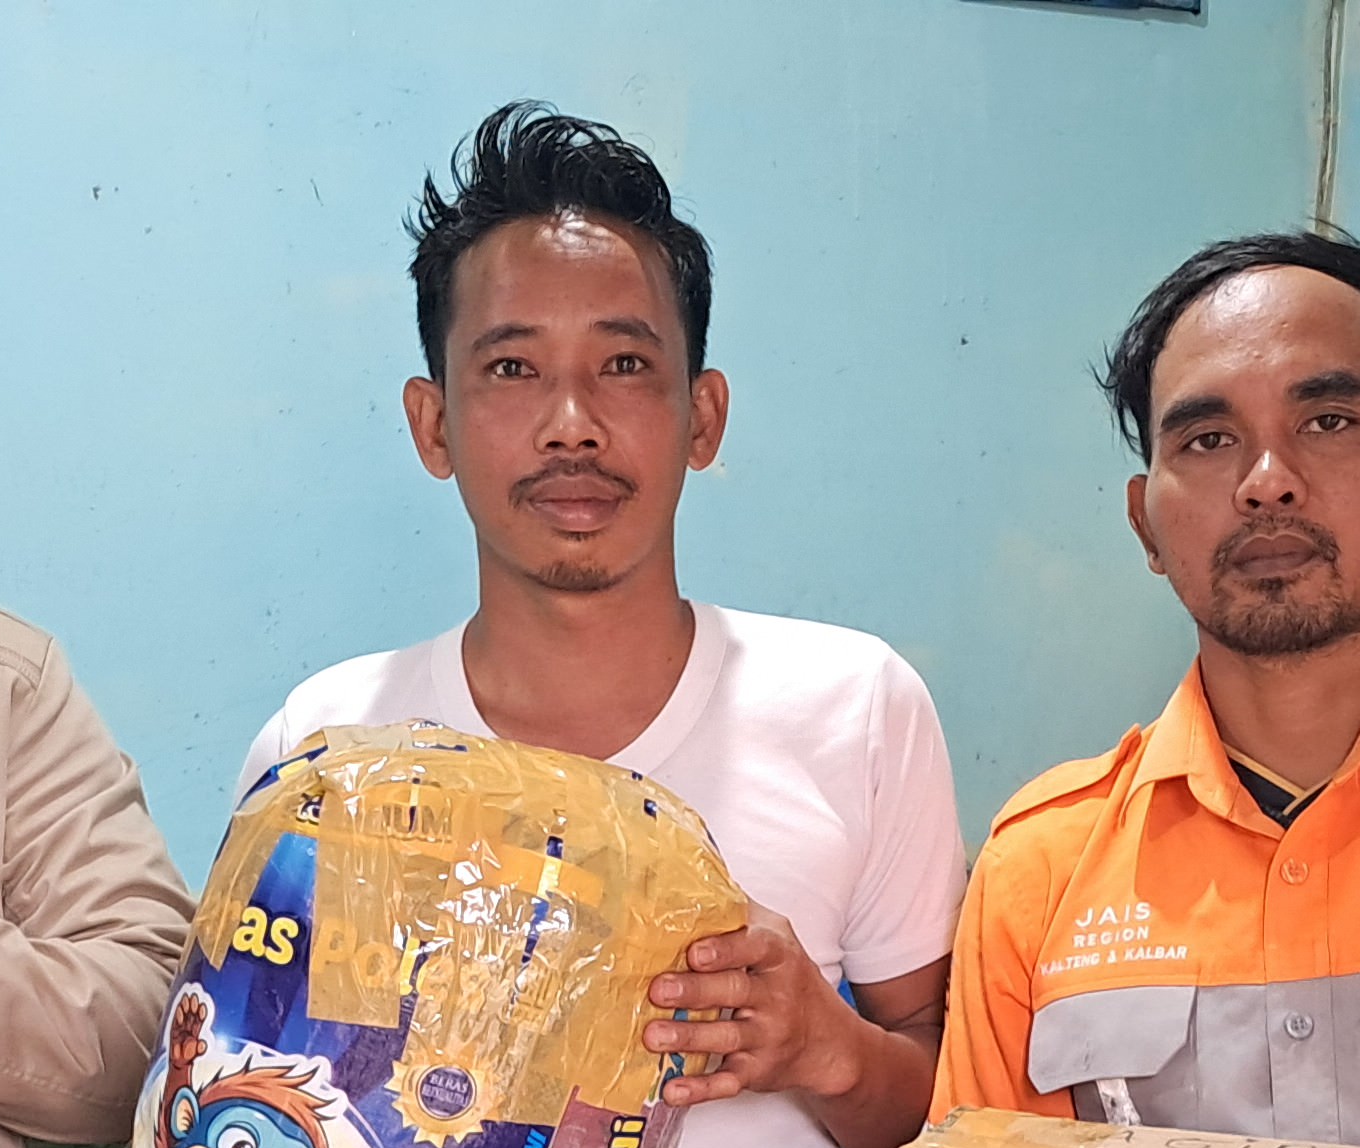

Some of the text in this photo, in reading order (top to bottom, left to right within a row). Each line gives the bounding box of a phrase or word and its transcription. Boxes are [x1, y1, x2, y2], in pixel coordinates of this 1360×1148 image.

[1075, 902, 1151, 928] JAIS
[1073, 926, 1150, 948] REGION
[1040, 953, 1100, 976] KALTENG
[1125, 946, 1188, 961] KALBAR
